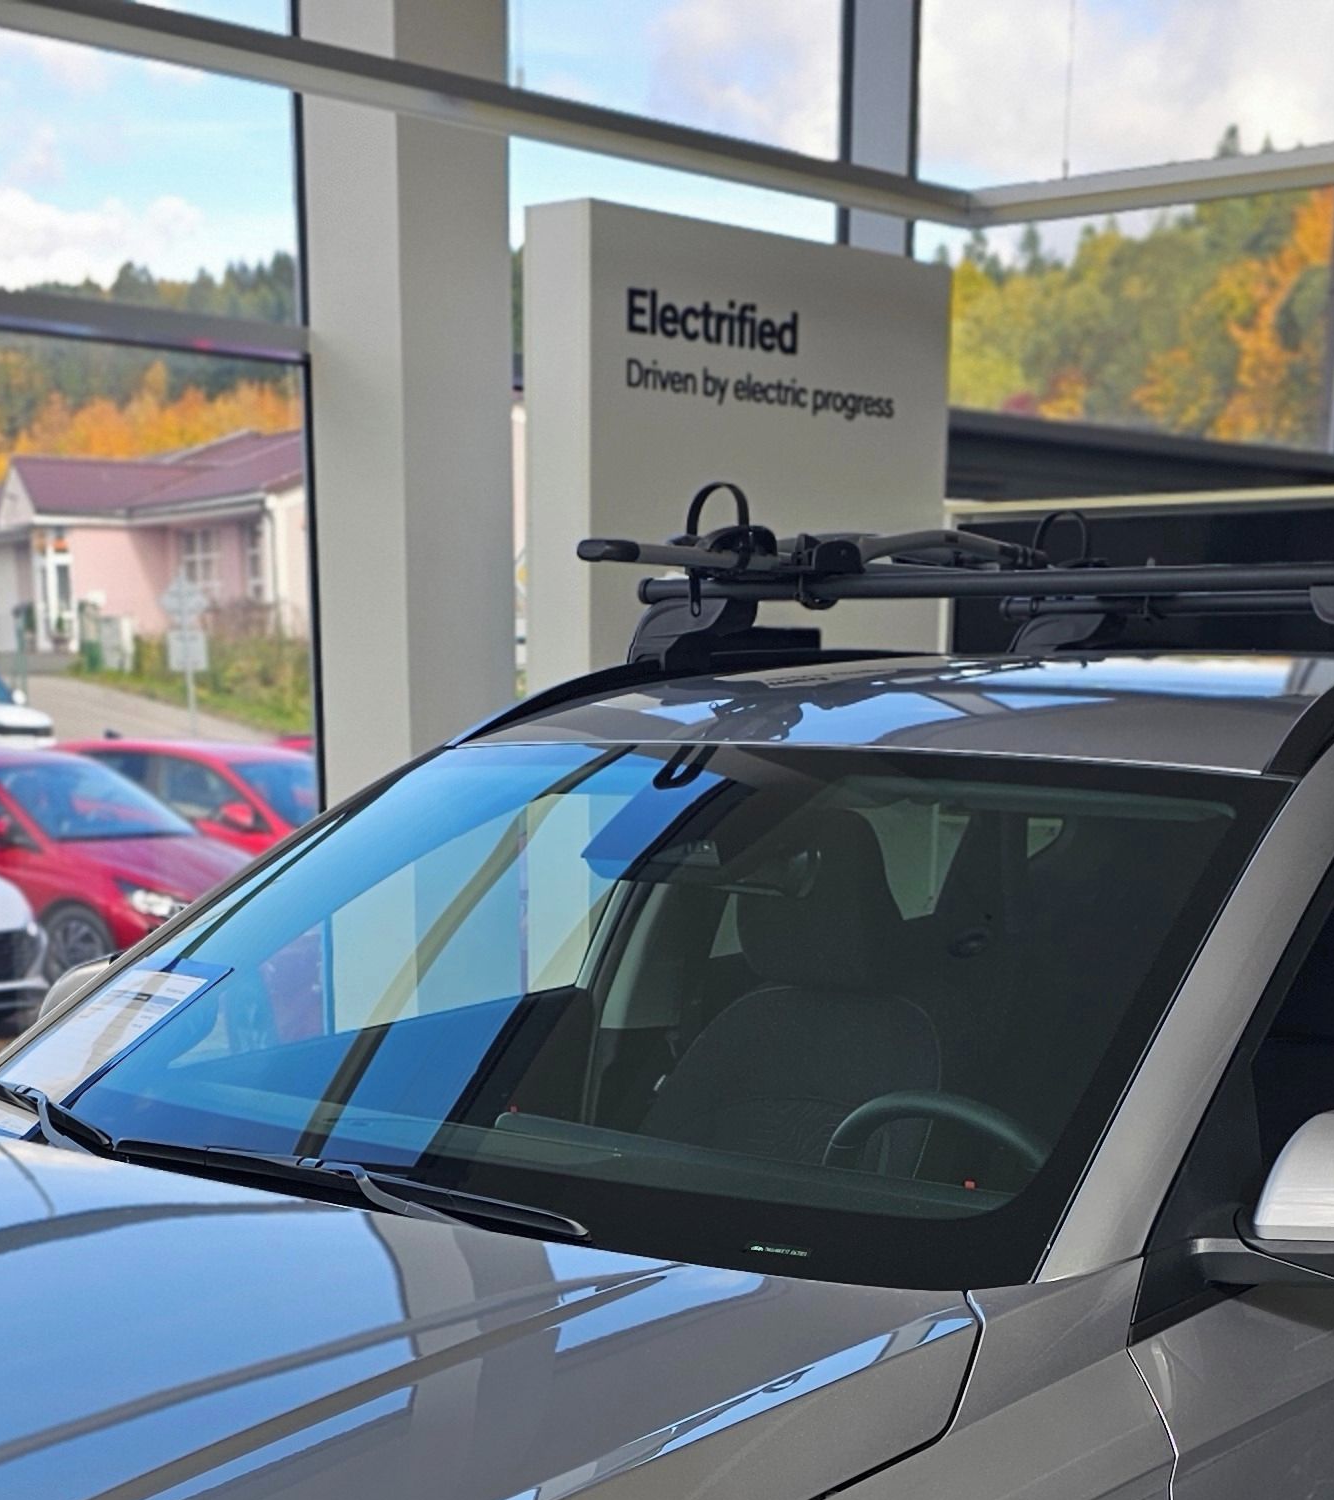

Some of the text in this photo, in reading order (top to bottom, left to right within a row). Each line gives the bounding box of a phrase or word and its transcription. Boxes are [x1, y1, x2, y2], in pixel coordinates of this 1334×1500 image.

[627, 287, 798, 355] Electrified
[626, 358, 895, 420] Driven by electric progress
